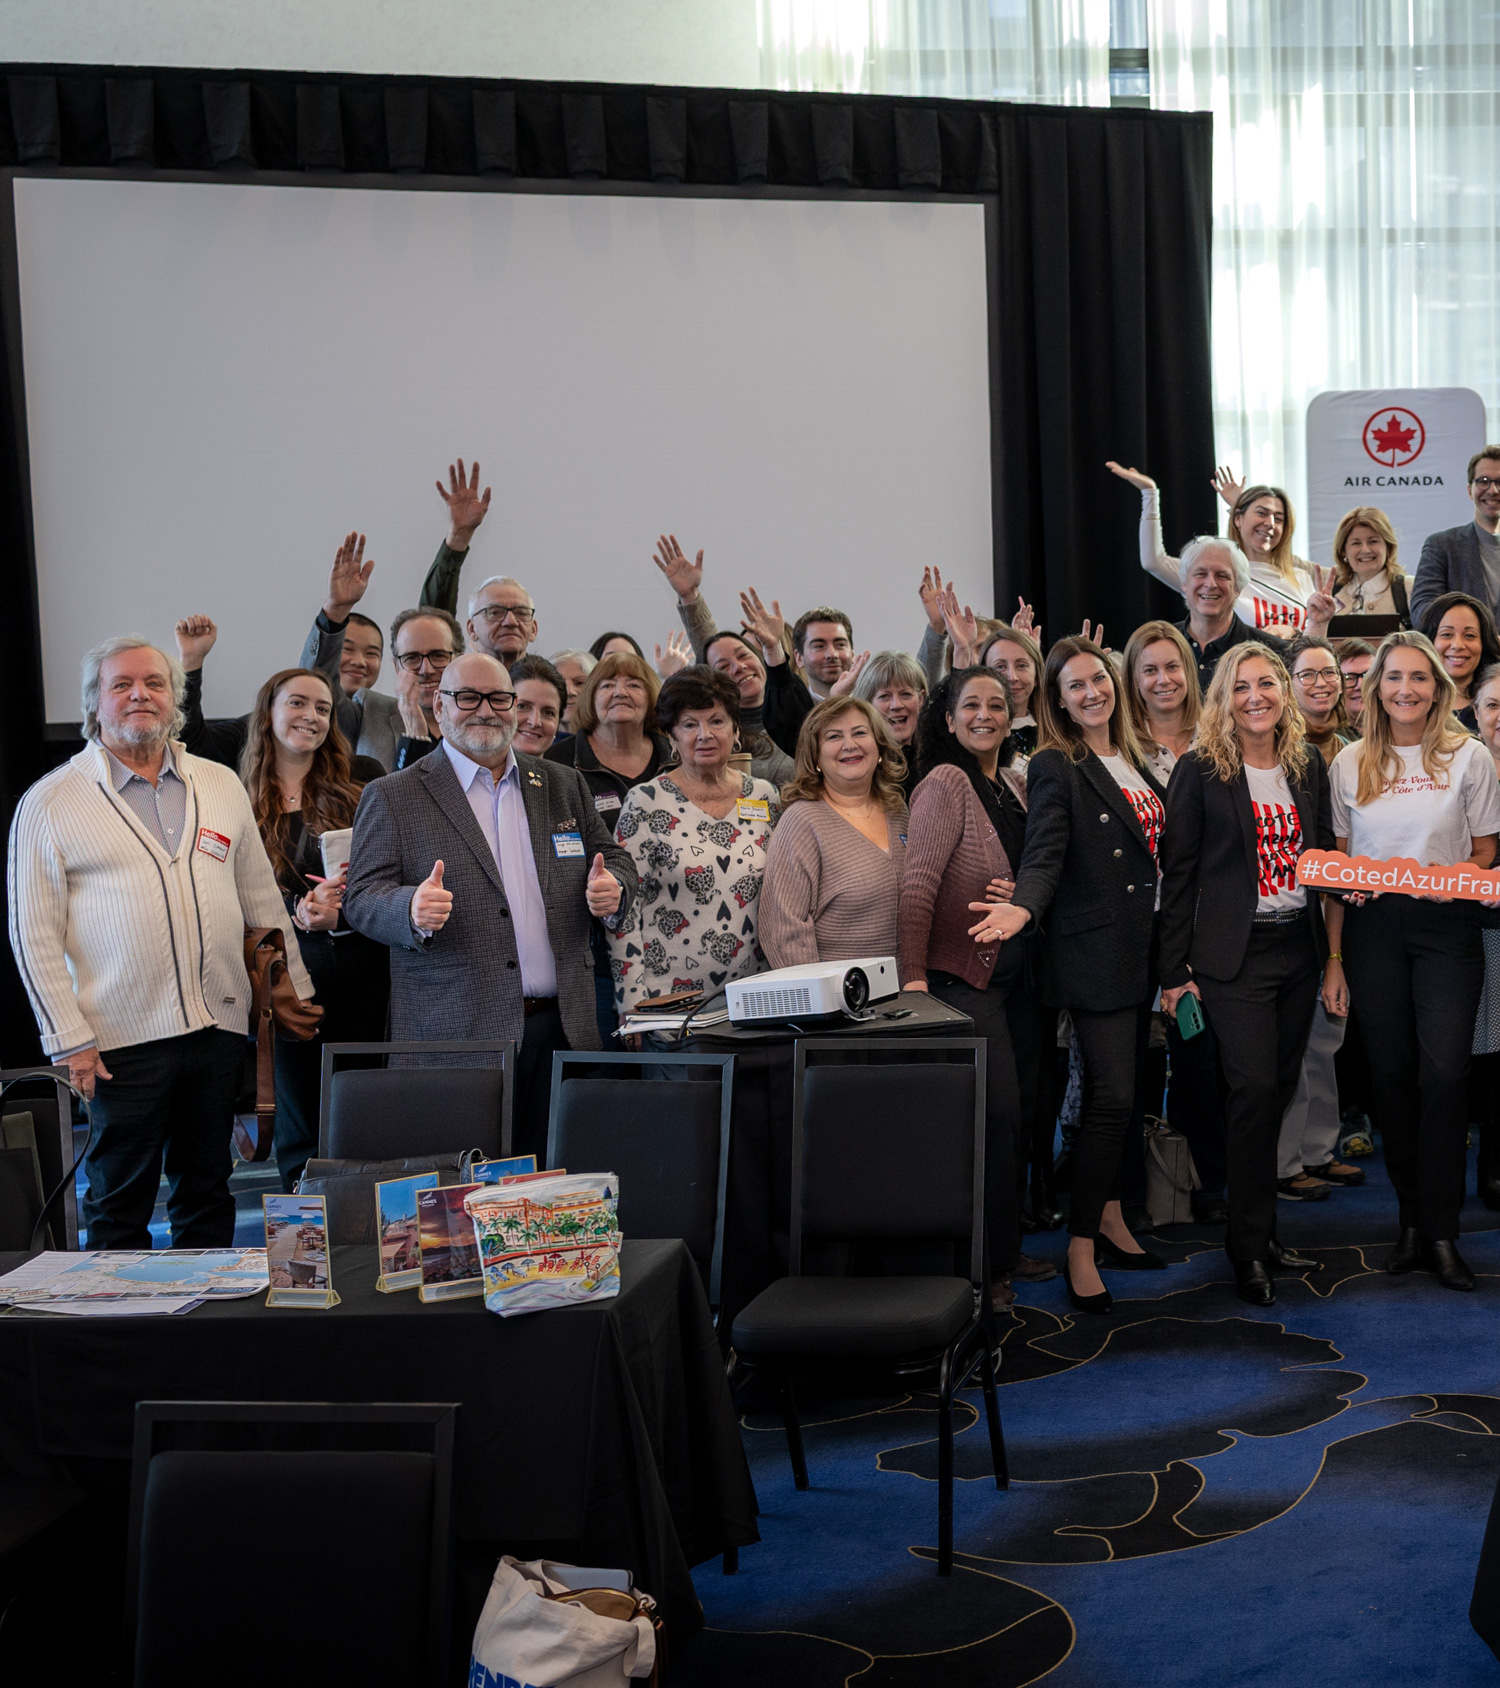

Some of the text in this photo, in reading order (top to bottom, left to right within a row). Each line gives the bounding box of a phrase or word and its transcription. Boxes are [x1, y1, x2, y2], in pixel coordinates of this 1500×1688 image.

[1344, 476, 1444, 486] AIR CANADA
[1257, 829, 1303, 847] 'AZUR
